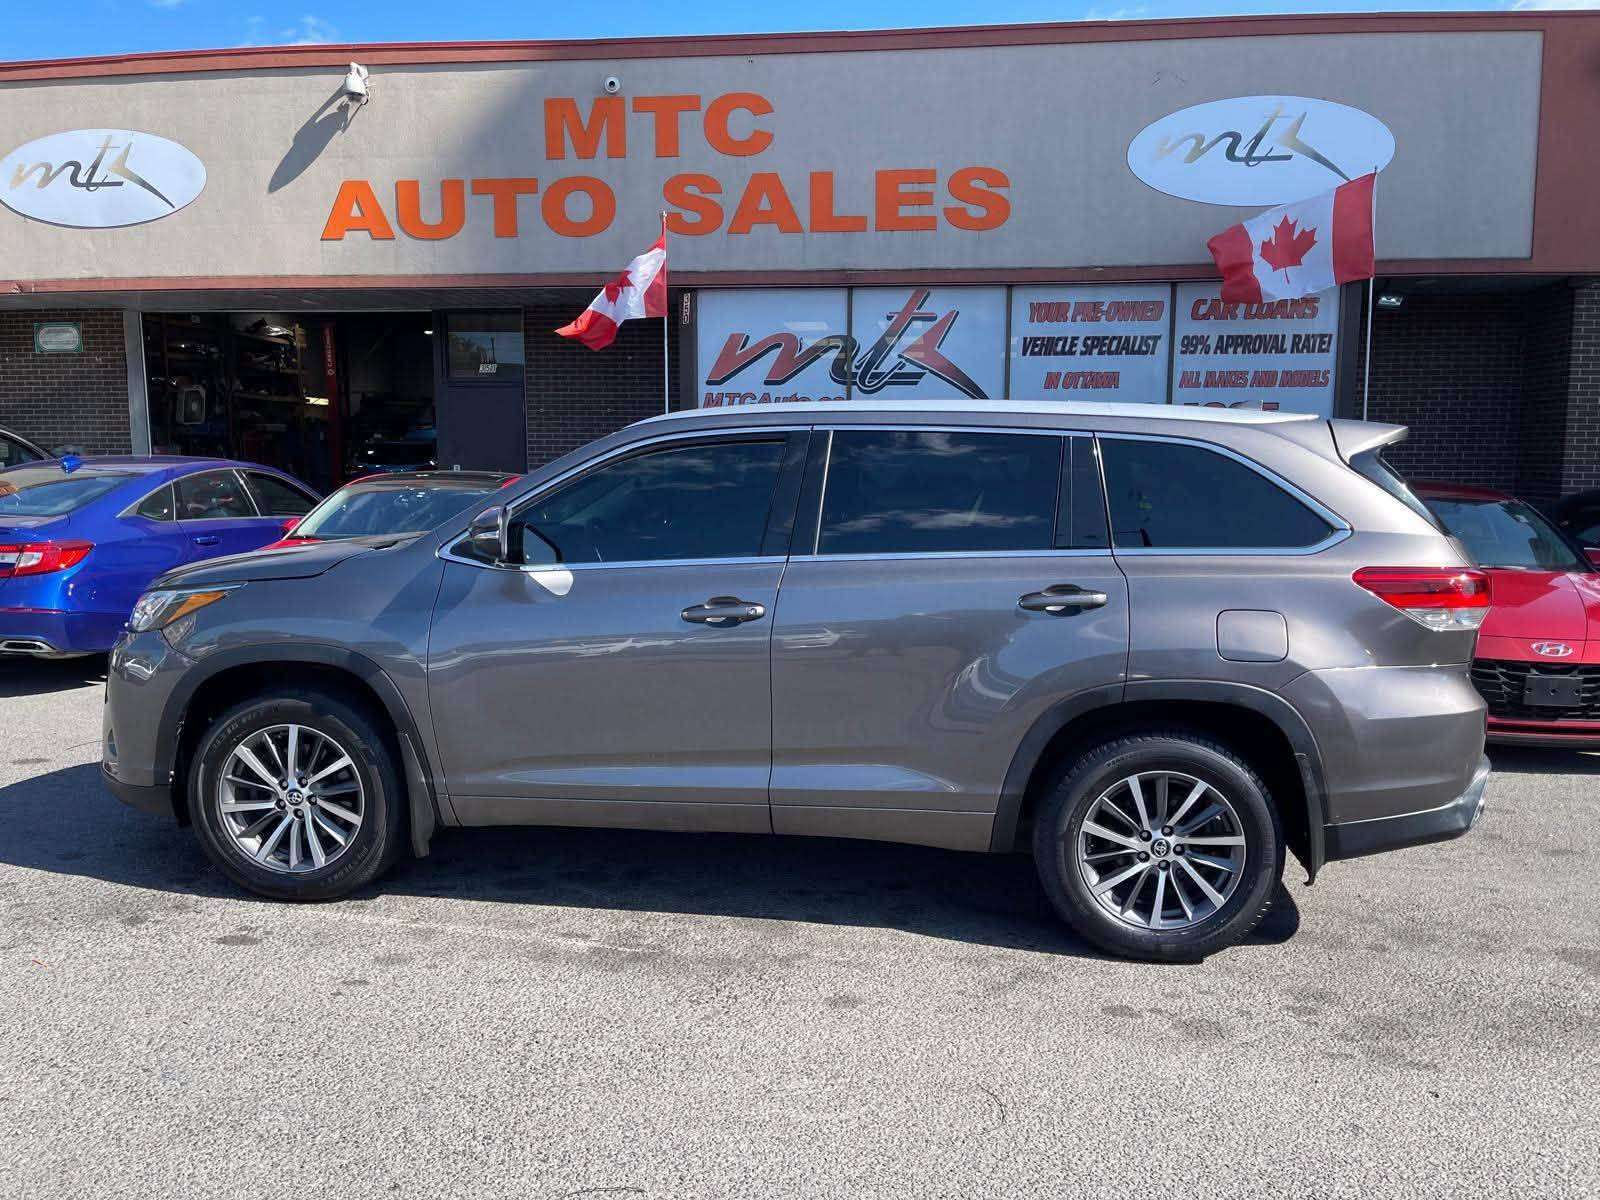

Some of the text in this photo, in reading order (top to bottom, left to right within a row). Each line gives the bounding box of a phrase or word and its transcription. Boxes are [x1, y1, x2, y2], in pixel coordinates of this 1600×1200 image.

[543, 93, 775, 160] MTC
[321, 167, 1011, 242] AUTO SALES
[1029, 300, 1165, 323] YOUR PRE-OWNED
[1190, 297, 1320, 321] CAR LOANS
[1022, 335, 1162, 356] VEHICLE SPECIALIST
[1180, 333, 1333, 355] 99% APPROVAL RATE!
[1044, 371, 1121, 390] IN OTTAWA
[1178, 369, 1331, 389] ALL MAKES AND MODELS
